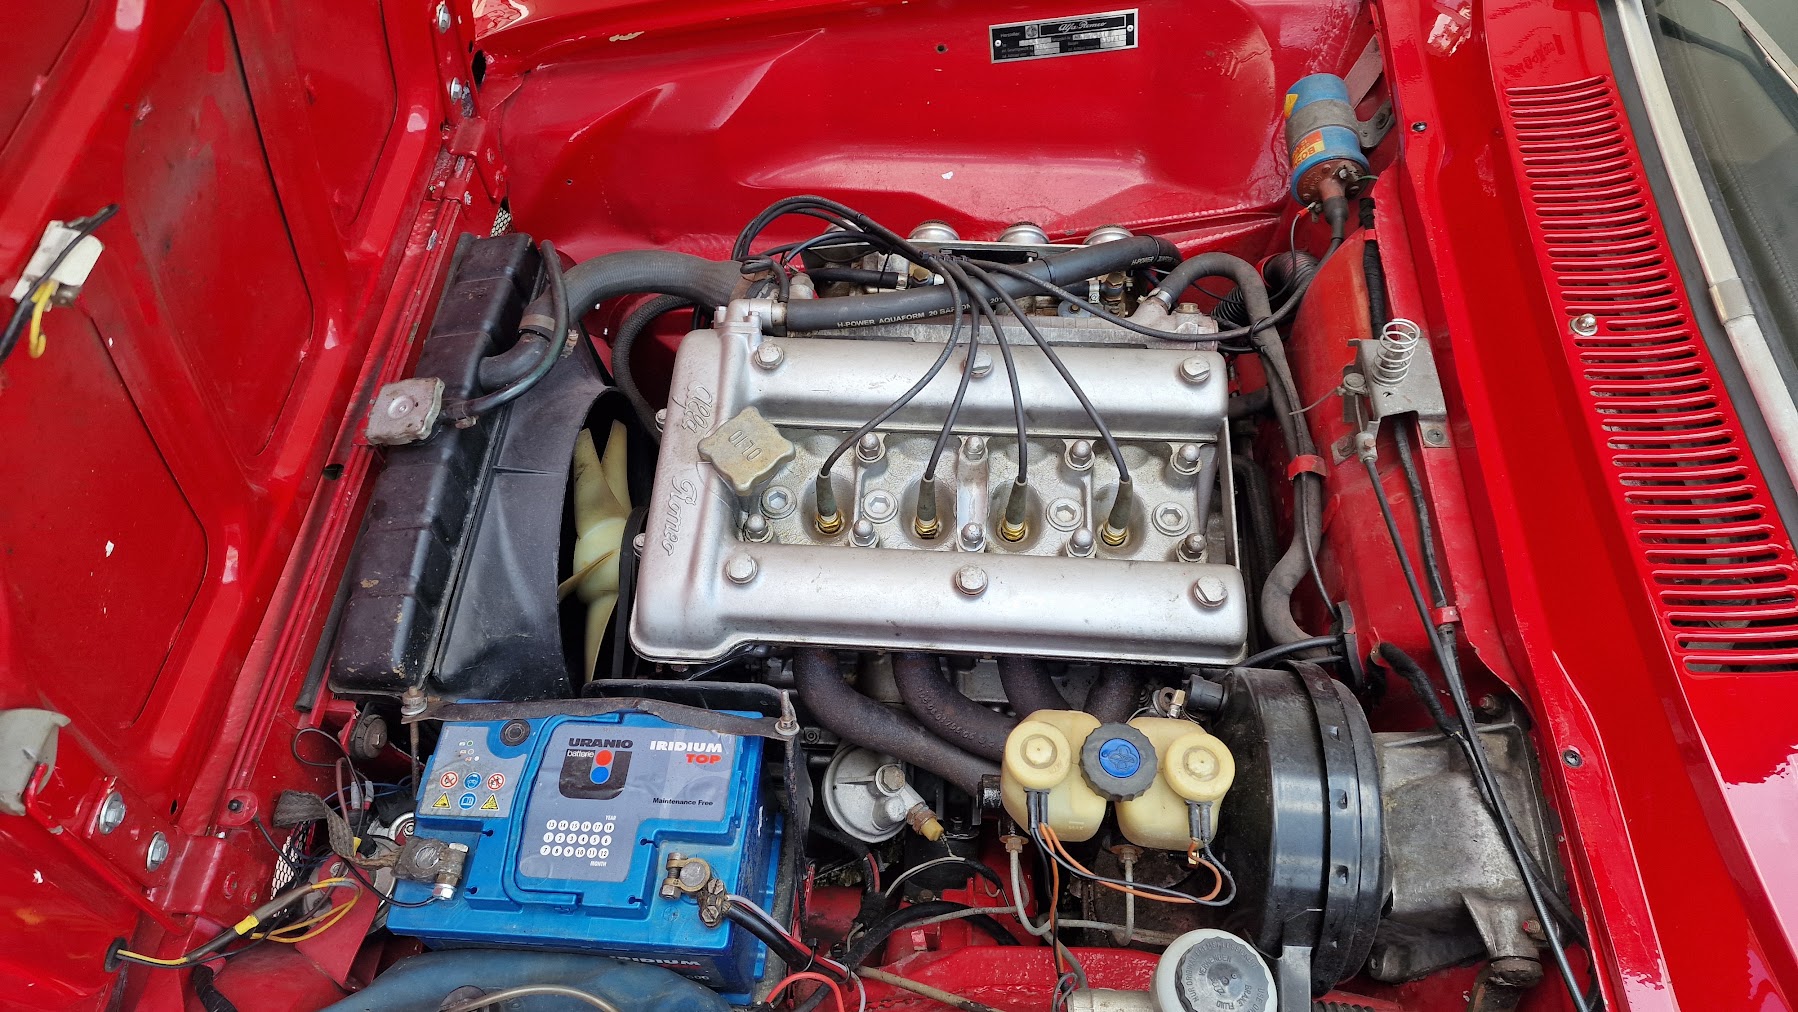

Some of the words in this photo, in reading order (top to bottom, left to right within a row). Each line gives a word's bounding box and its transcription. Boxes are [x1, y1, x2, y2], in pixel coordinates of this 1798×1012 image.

[1058, 23, 1077, 33] Alfa
[1079, 20, 1107, 29] Romeo
[837, 319, 875, 328] H-POWER
[879, 312, 925, 324] AQUAFORM
[672, 380, 713, 434] Alfa
[728, 430, 763, 462] OLIO
[662, 476, 698, 557] Romeo
[568, 738, 634, 749] URANIO
[650, 740, 723, 753] IRIDIUM
[567, 750, 595, 758] batterie
[685, 753, 722, 764] TOP
[652, 797, 697, 806] Maintenance
[697, 799, 714, 807] Free
[1237, 984, 1252, 1007] BRAKE
[1216, 1000, 1235, 1010] FLUID
